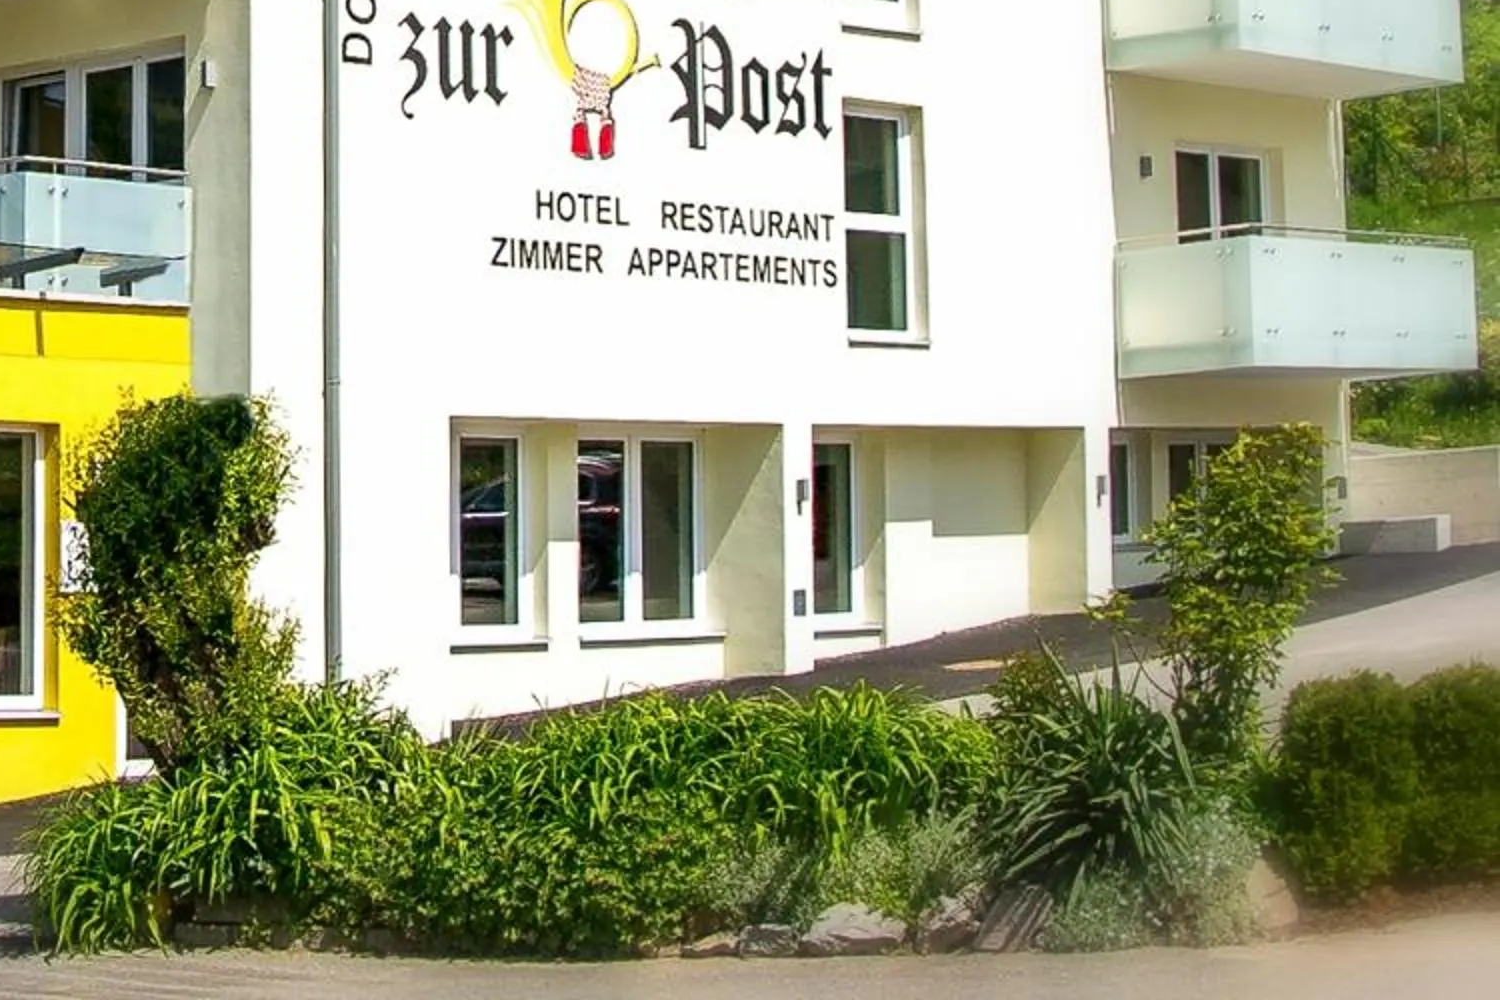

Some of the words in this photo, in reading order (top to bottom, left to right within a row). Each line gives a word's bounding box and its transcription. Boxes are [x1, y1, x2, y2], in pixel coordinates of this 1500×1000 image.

[397, 11, 514, 120] zur
[669, 18, 833, 151] Post
[536, 189, 630, 227] HOTEL
[661, 201, 835, 242] RESTAURANT
[491, 236, 603, 274] ZIMMER
[627, 247, 838, 288] APPARTEMENTS
